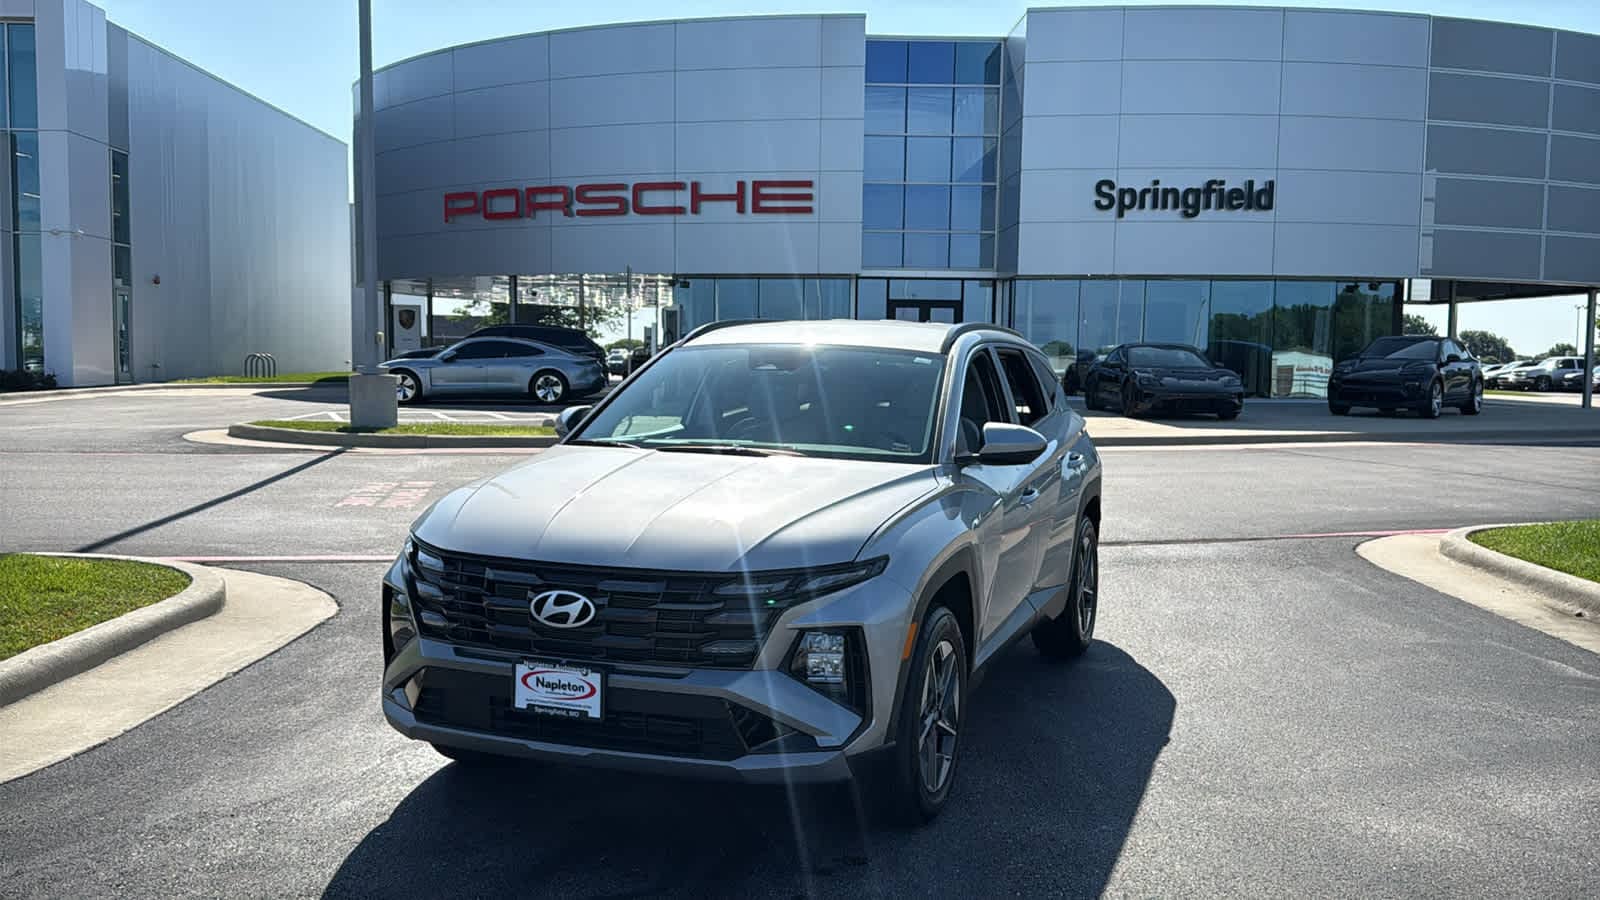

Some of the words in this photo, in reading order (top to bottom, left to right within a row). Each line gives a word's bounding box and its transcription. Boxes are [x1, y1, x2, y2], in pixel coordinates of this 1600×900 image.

[444, 180, 814, 223] PORSCHE
[1094, 179, 1275, 219] Springfield
[535, 676, 585, 692] Napleton
